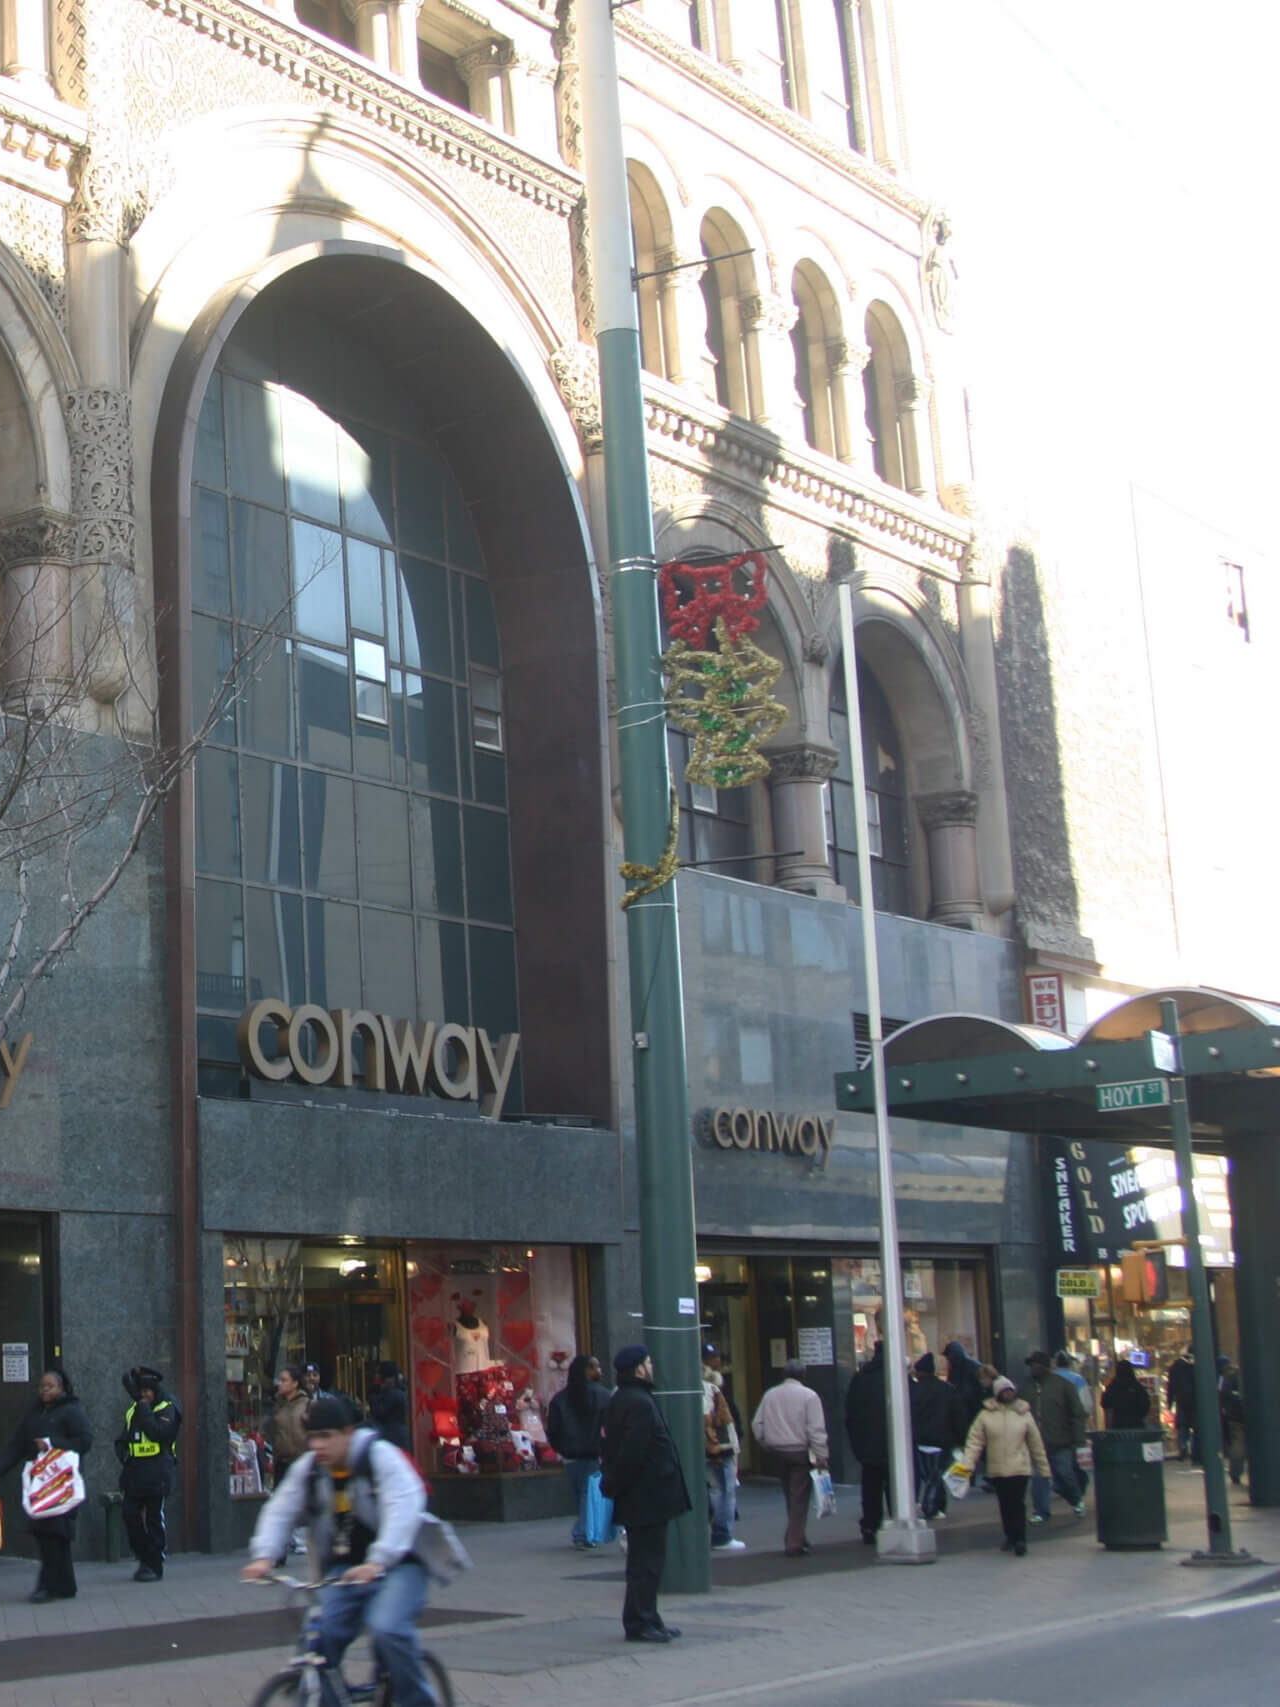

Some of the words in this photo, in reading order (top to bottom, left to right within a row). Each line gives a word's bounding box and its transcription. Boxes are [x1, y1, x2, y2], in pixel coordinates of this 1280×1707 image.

[1100, 1084, 1145, 1108] HOYT
[1055, 1157, 1076, 1252] SNEAKER
[1070, 1142, 1106, 1234] GOLD
